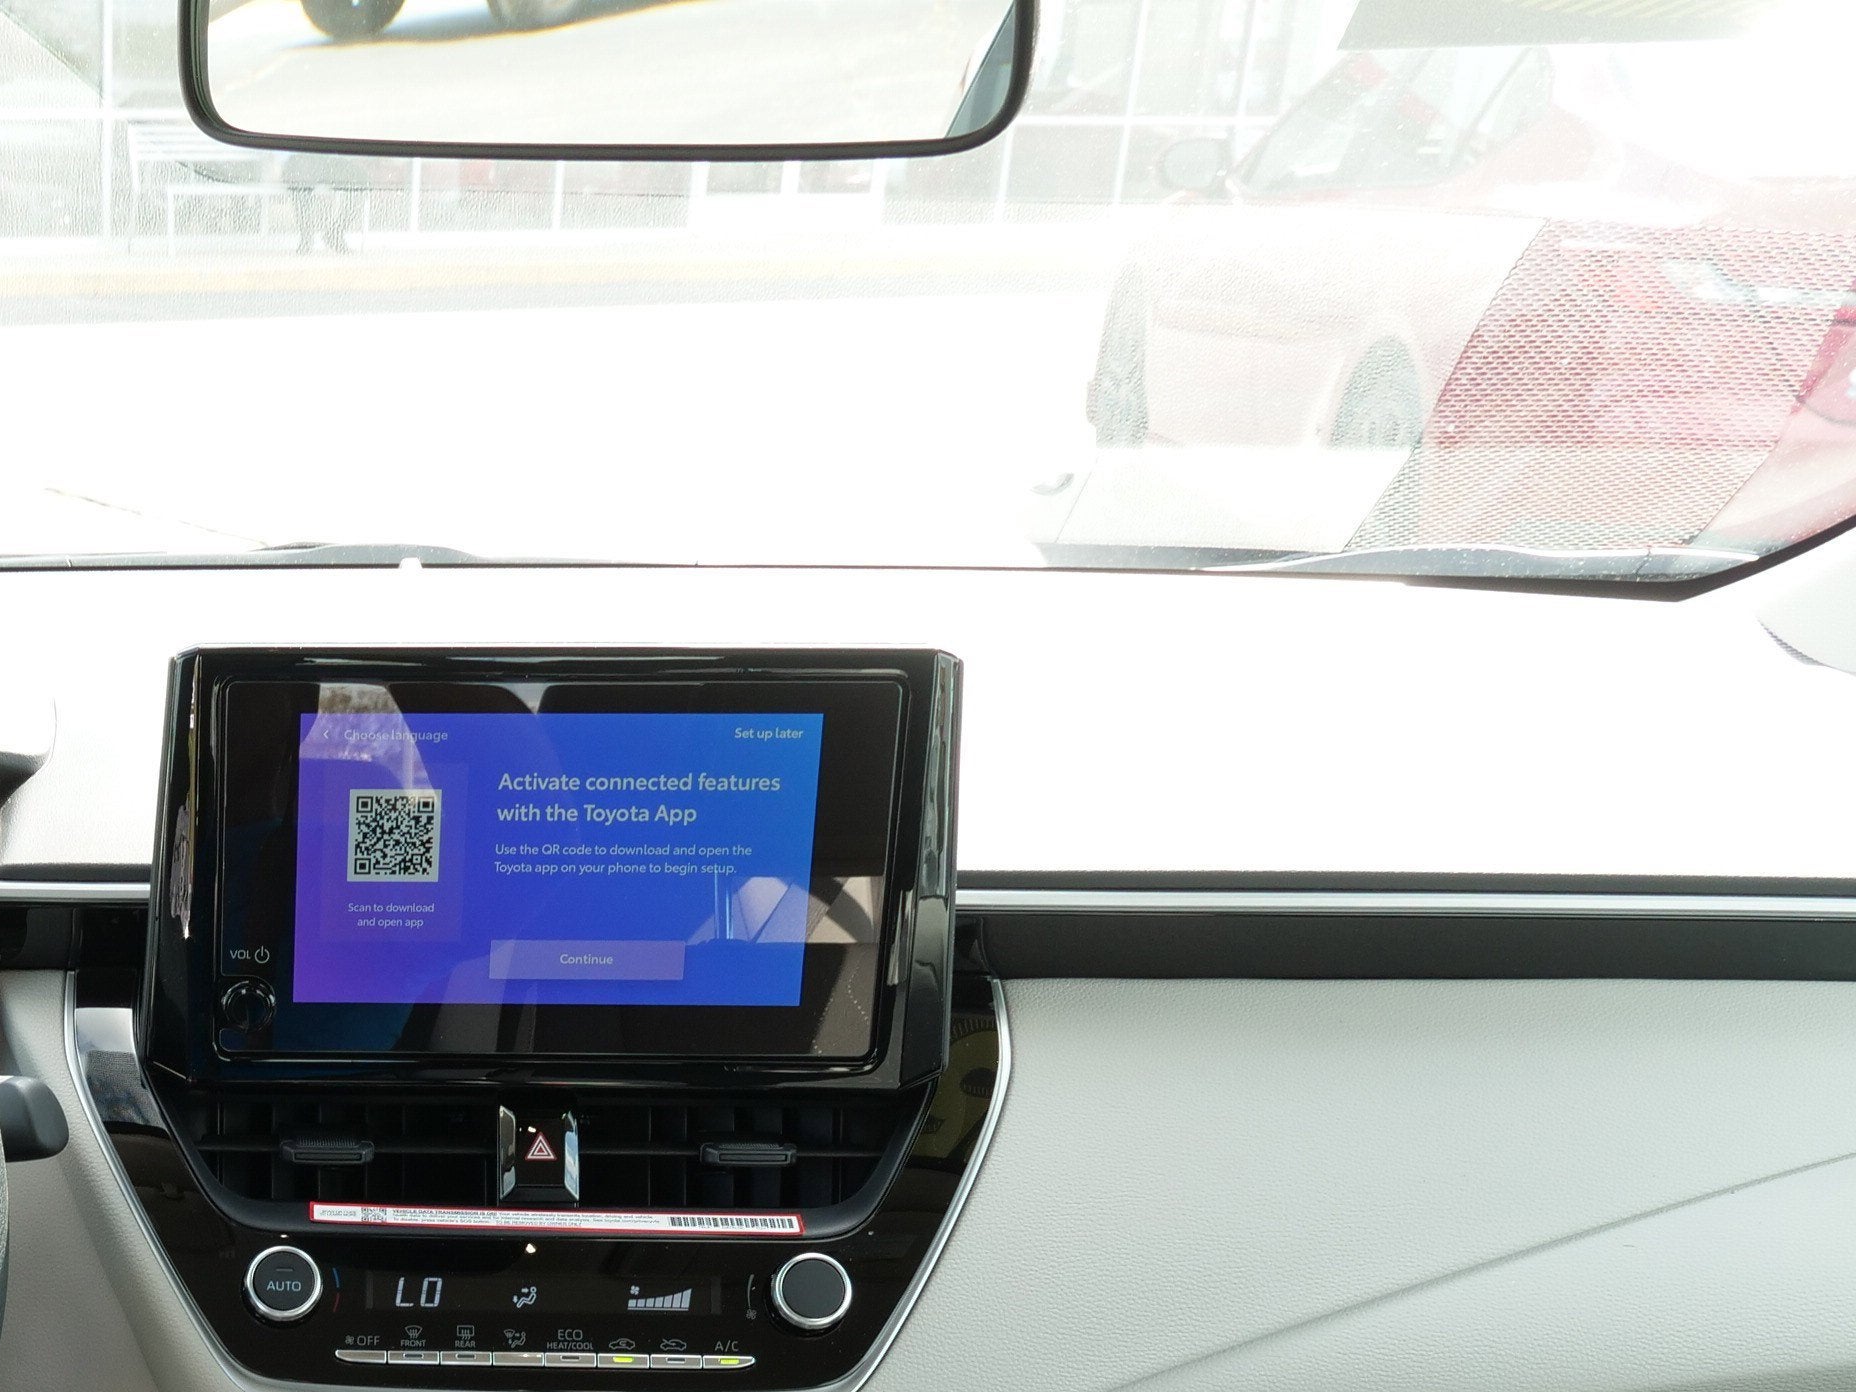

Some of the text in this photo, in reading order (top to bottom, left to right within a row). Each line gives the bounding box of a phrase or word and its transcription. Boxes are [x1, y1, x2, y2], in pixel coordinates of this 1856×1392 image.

[344, 728, 448, 744] Choose language
[734, 727, 803, 741] Set up later
[498, 772, 781, 791] Activate connected features
[496, 804, 697, 826] with the Toyota App
[495, 844, 752, 858] Use the QR code to download and open the
[494, 862, 737, 876] Toyota app on your phone to begin setup.
[348, 902, 435, 912] Scan to download
[357, 918, 424, 929] and open app
[230, 949, 251, 960] VOL
[560, 954, 614, 965] Continue
[266, 1280, 302, 1292] AUTO
[395, 1276, 443, 1308] LO
[557, 1329, 583, 1340] ECO
[356, 1335, 380, 1346] OFF
[400, 1340, 426, 1348] FRONT
[454, 1340, 476, 1348] REAR
[546, 1341, 594, 1350] HEAT/COOL
[714, 1340, 739, 1352] A/C
